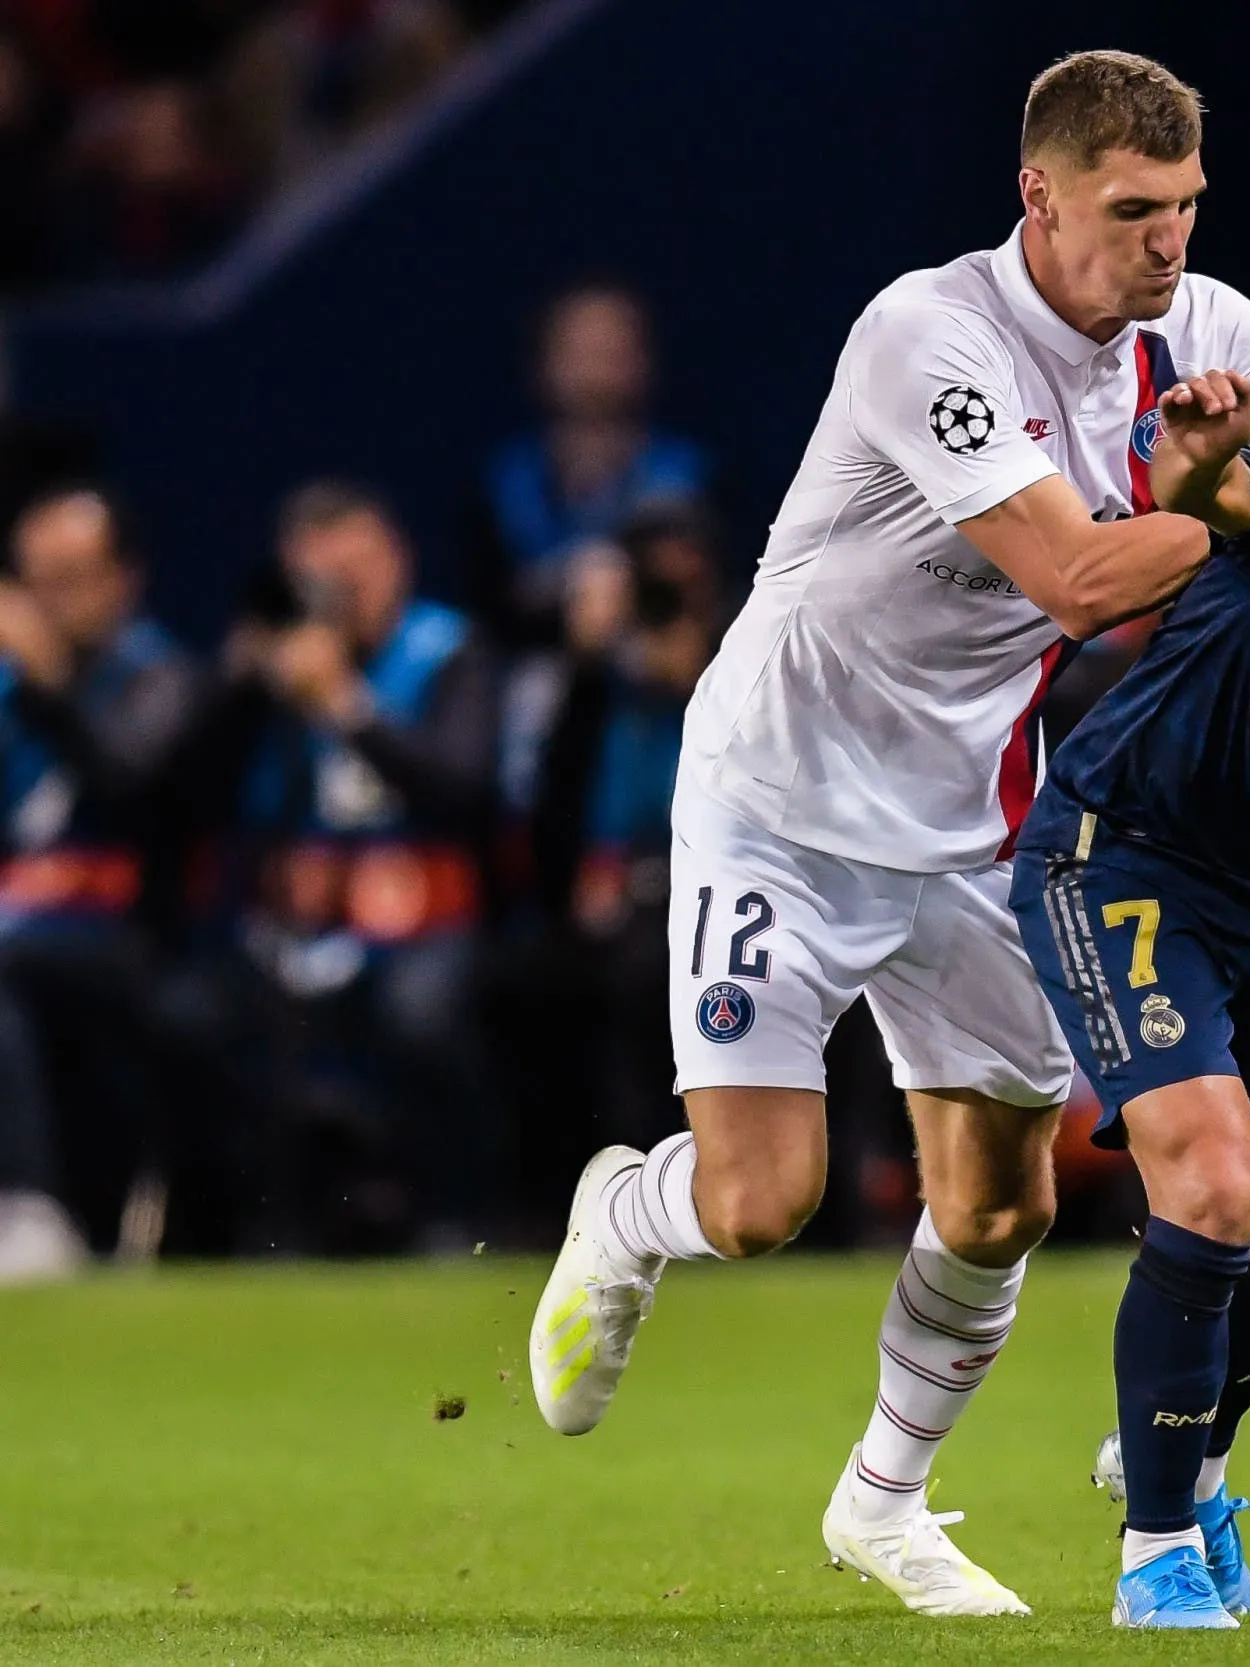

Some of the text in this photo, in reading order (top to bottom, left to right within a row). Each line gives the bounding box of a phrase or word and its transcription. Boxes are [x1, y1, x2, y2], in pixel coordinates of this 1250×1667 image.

[1023, 418, 1050, 433] NIKE
[916, 560, 1001, 592] ACCOR
[692, 886, 776, 983] 12
[1102, 899, 1160, 988] 7
[706, 987, 742, 1001] PARIS
